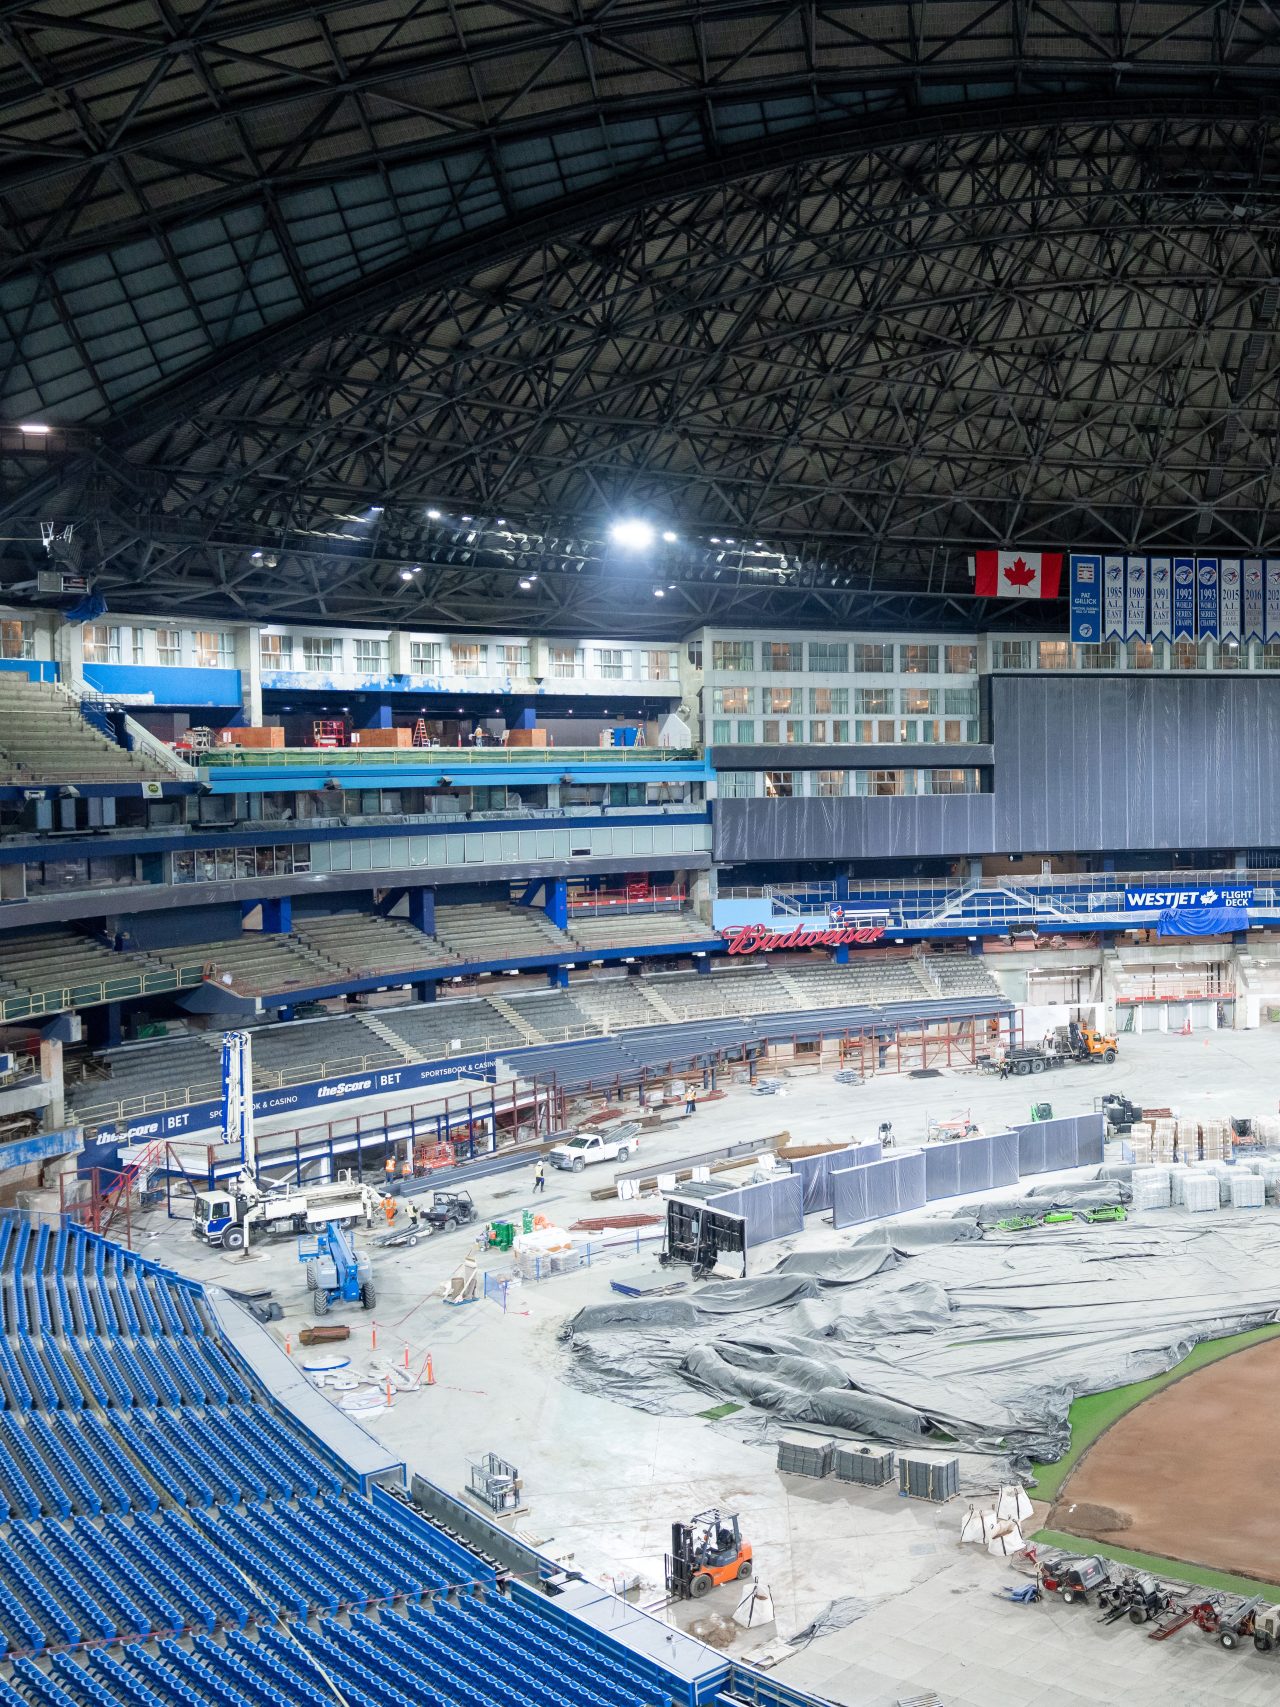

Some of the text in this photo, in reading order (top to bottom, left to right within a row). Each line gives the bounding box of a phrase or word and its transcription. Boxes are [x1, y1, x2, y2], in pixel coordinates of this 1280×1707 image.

[1106, 587, 1122, 598] 1985
[1128, 587, 1144, 598] 1989
[1154, 588, 1169, 599] 1991
[1176, 589, 1192, 599] 1992
[1200, 590, 1216, 600] 1993
[1223, 590, 1239, 600] 2015
[1246, 590, 1261, 600] 2016
[1128, 610, 1144, 618] EAST
[1154, 611, 1169, 619] EAST
[1200, 610, 1216, 618] SERIES
[1222, 890, 1252, 899] FLIGHT
[1127, 892, 1199, 908] WESTJET
[1226, 898, 1248, 907] DECK
[722, 922, 885, 954] Budweiser
[421, 1066, 467, 1079] SPORTSBOOK
[317, 1072, 401, 1098] theScore BET
[270, 1095, 298, 1107] CASINO
[167, 1113, 189, 1129] BET
